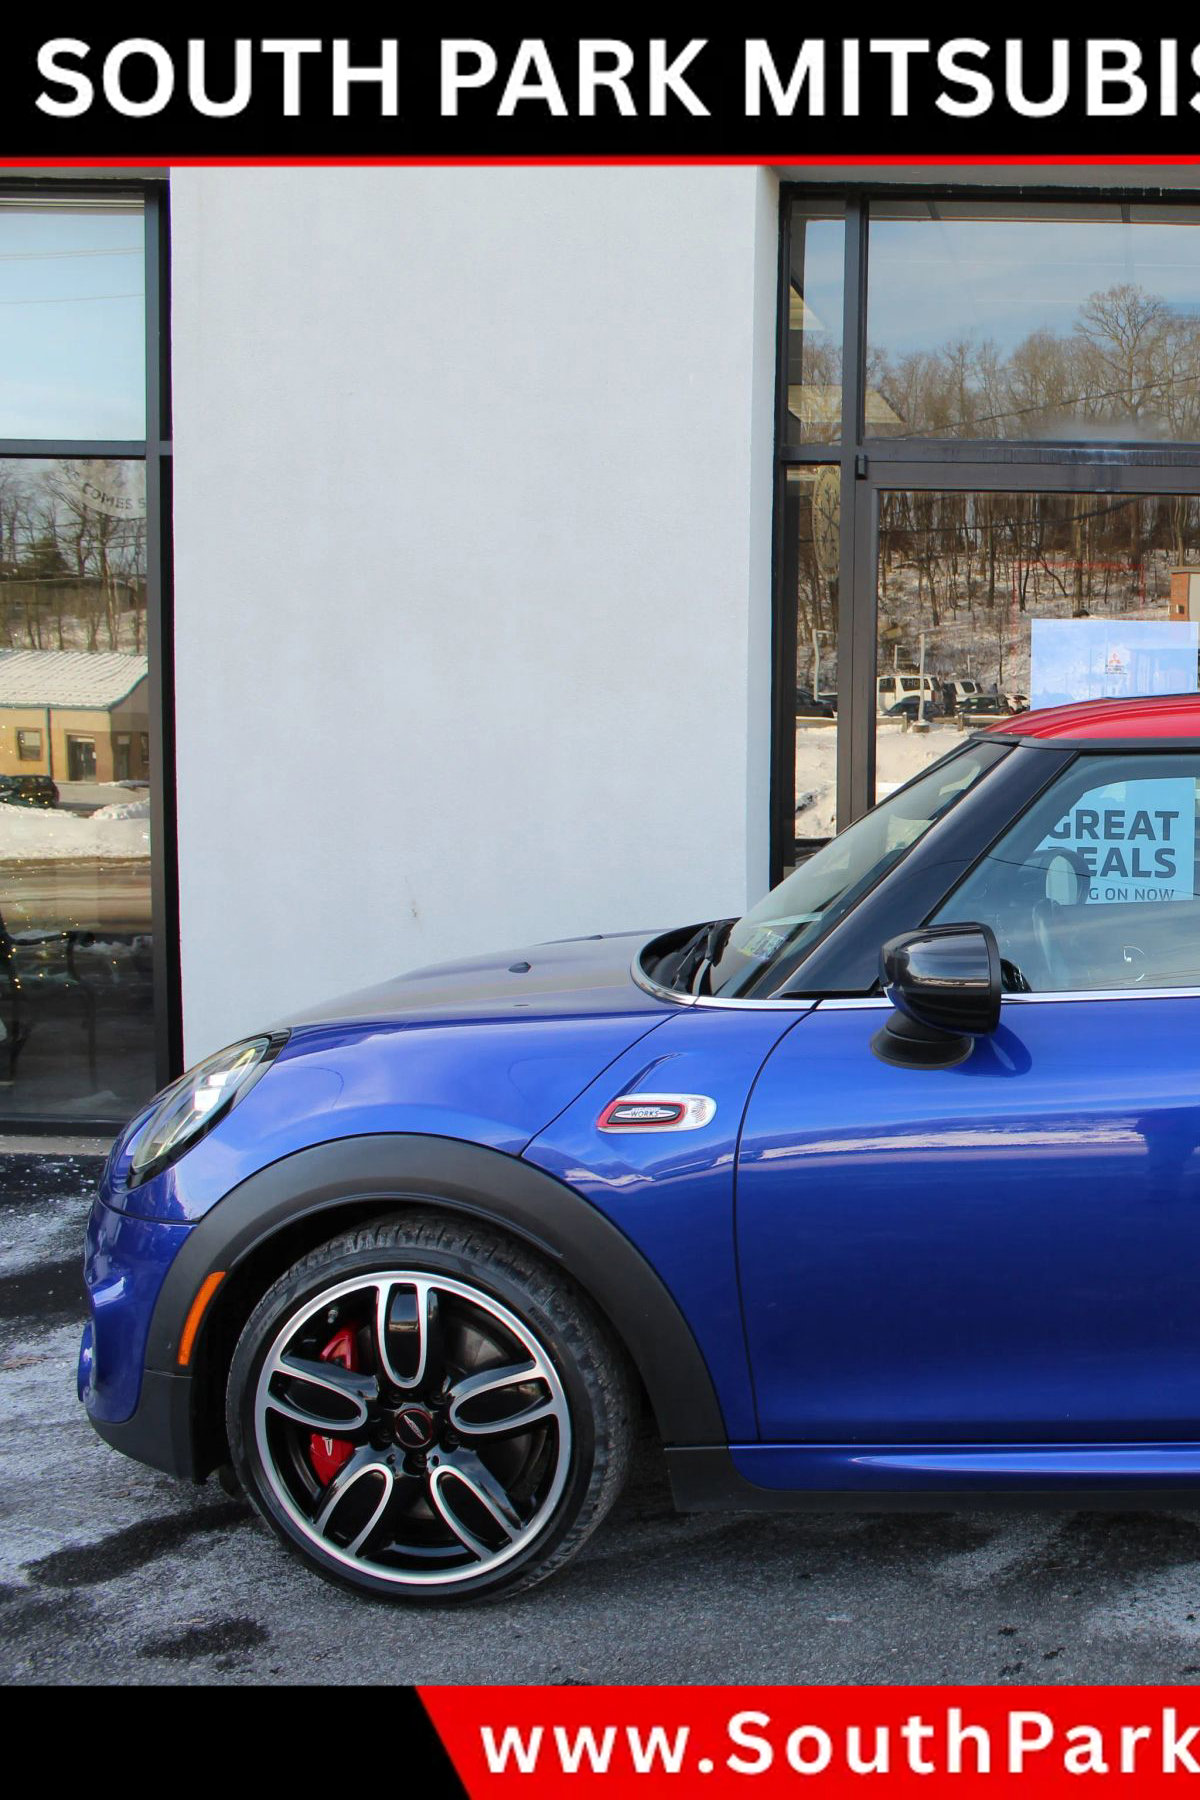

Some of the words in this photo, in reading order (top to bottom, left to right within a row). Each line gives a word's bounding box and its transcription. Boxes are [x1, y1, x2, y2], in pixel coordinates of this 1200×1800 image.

[1048, 846, 1177, 879] EALS
[1105, 888, 1128, 901] ON
[1135, 888, 1175, 901] NOW
